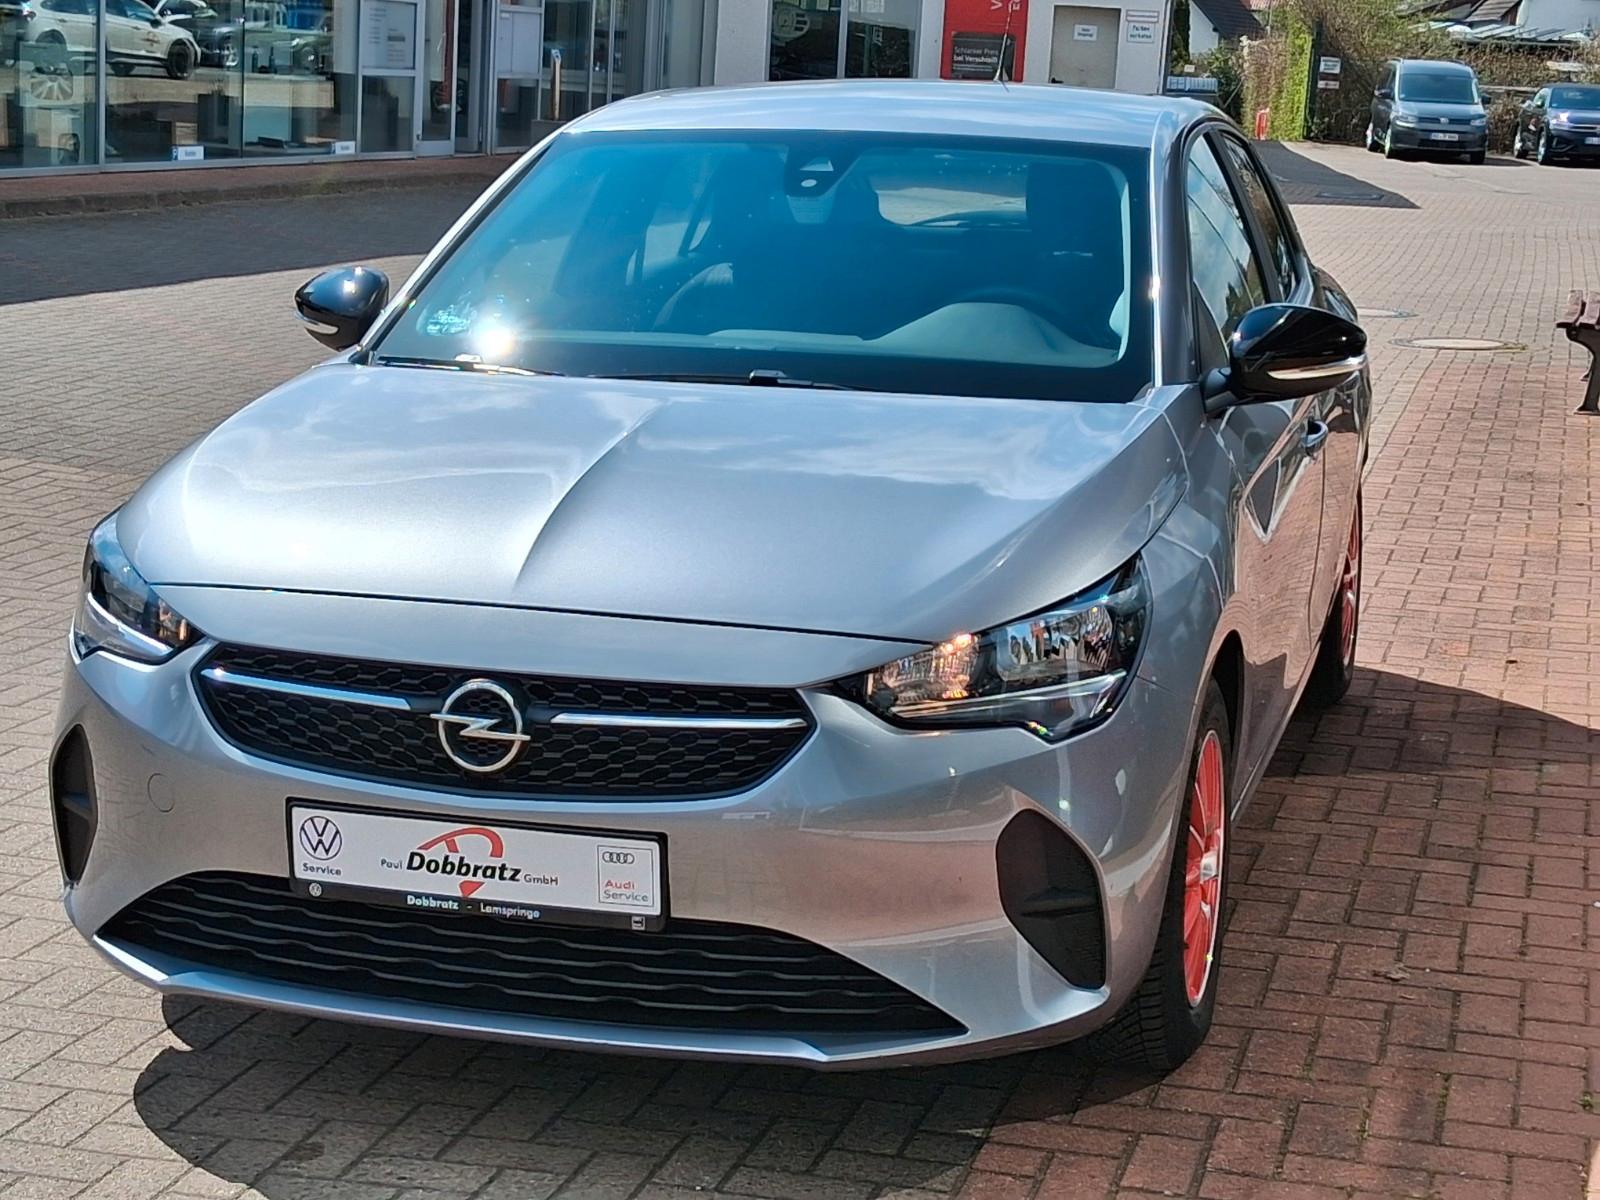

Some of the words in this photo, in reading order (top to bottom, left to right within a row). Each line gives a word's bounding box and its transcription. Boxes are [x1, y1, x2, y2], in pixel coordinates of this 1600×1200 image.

[302, 862, 342, 877] Service
[380, 858, 403, 870] Paul
[406, 851, 522, 882] Dobbratz
[523, 873, 559, 886] GmbH
[604, 879, 635, 890] Audi
[603, 889, 649, 903] Service
[406, 894, 460, 911] Dobbratz
[479, 902, 541, 920] Lamspringe
